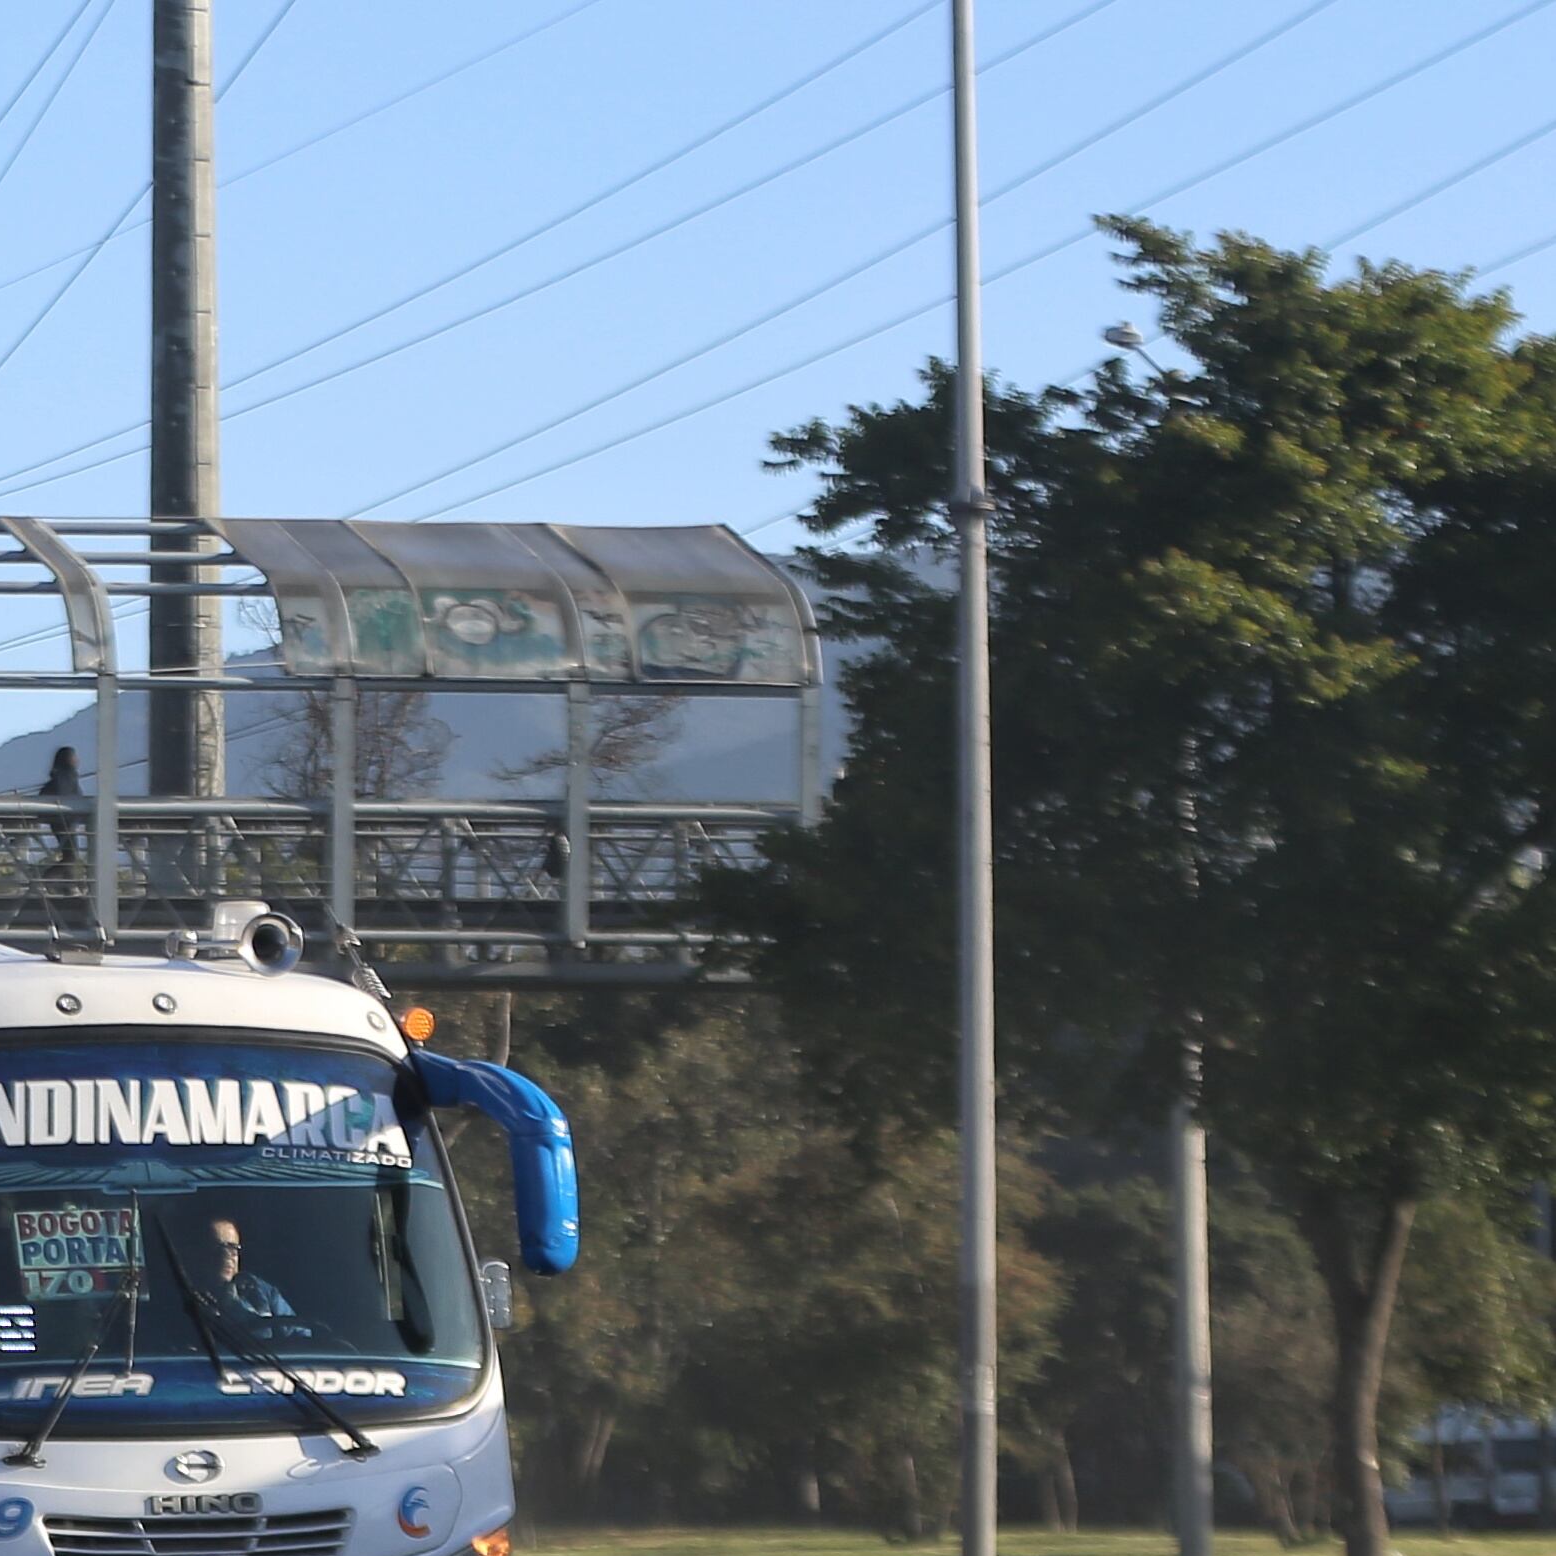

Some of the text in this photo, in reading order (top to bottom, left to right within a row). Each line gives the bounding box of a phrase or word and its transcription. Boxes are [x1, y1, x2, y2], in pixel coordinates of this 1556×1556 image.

[261, 1147, 413, 1169] CLIMATIZADO
[16, 1210, 132, 1241] BOGOTA
[21, 1237, 143, 1266] PORTAL
[23, 1270, 94, 1295] 170
[220, 1369, 407, 1397] CONDOR
[145, 1491, 264, 1516] HINO
